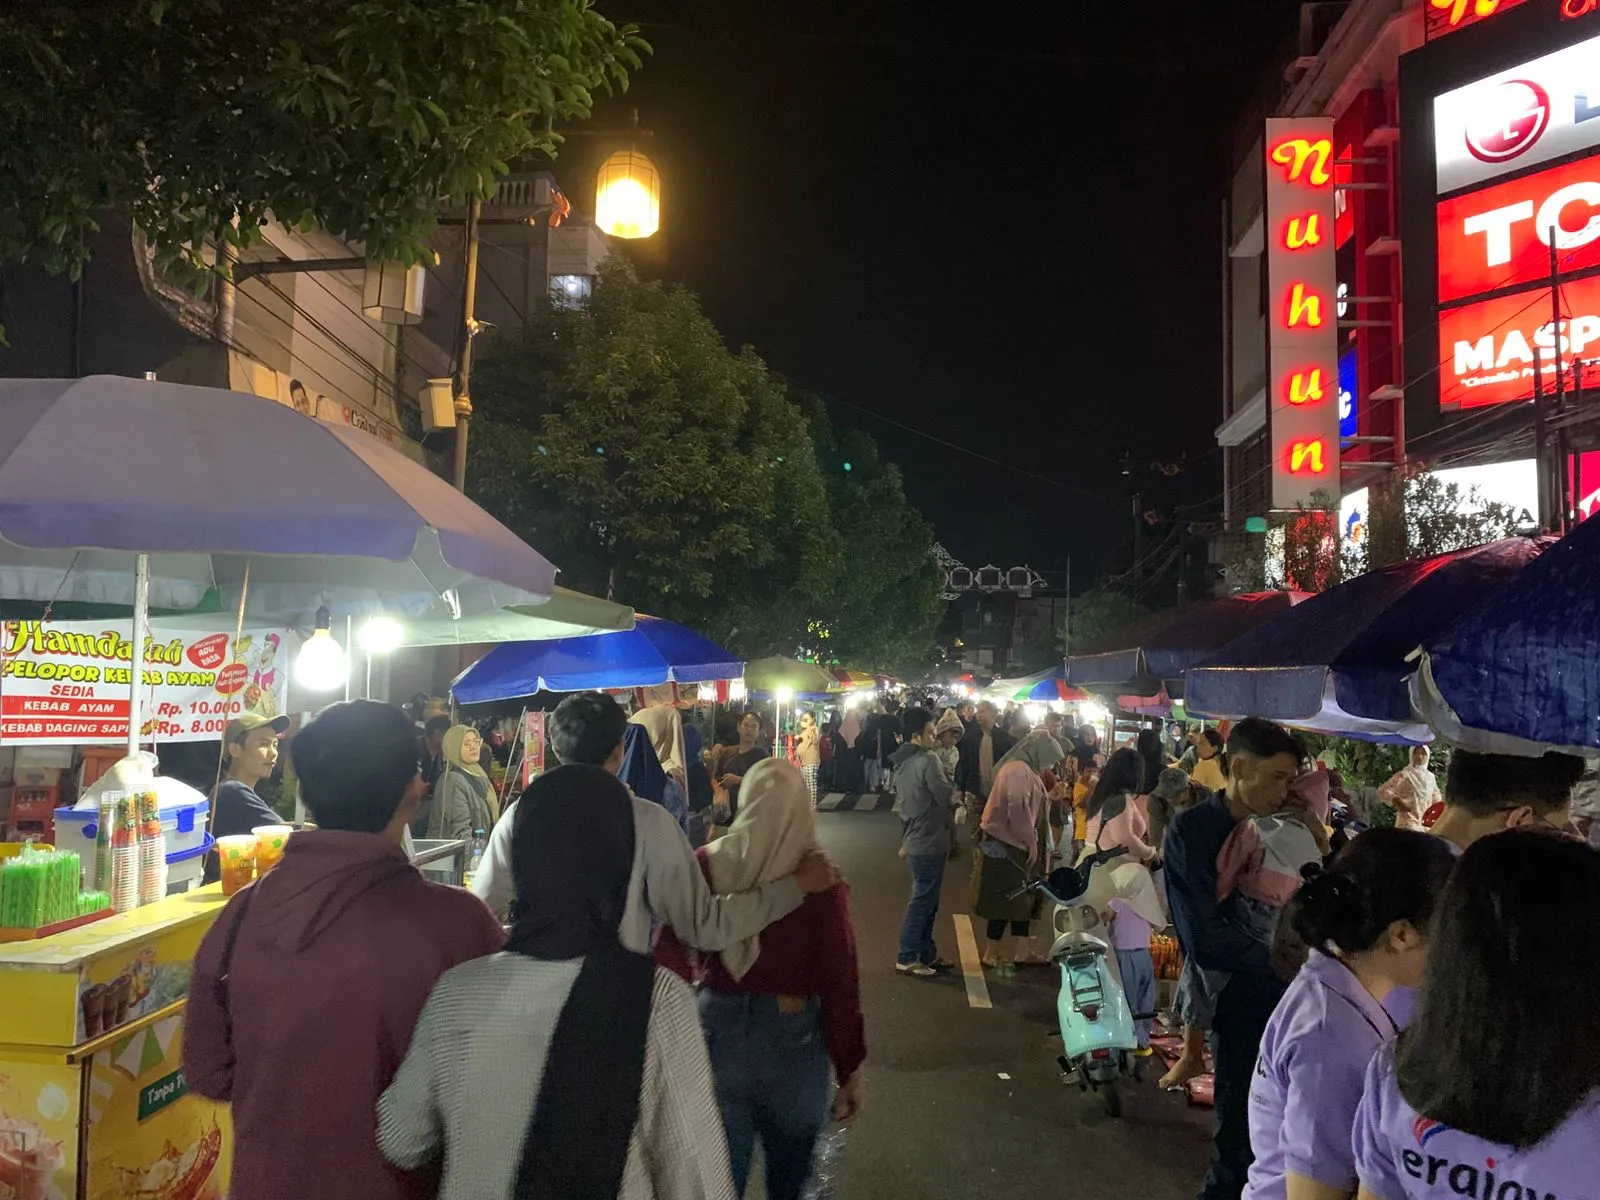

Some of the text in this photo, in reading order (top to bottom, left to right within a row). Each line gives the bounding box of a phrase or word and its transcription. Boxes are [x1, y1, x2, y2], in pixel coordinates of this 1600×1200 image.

[1, 659, 100, 682] PELOPOR
[166, 671, 216, 687] AYAM
[50, 684, 94, 697] SEDIA
[24, 700, 70, 711] KEBAB
[78, 703, 115, 713] AYAM
[157, 702, 182, 718] Rp.
[1, 723, 42, 733] KEBAB
[46, 724, 97, 733] DAGING
[157, 720, 185, 736] Rp.
